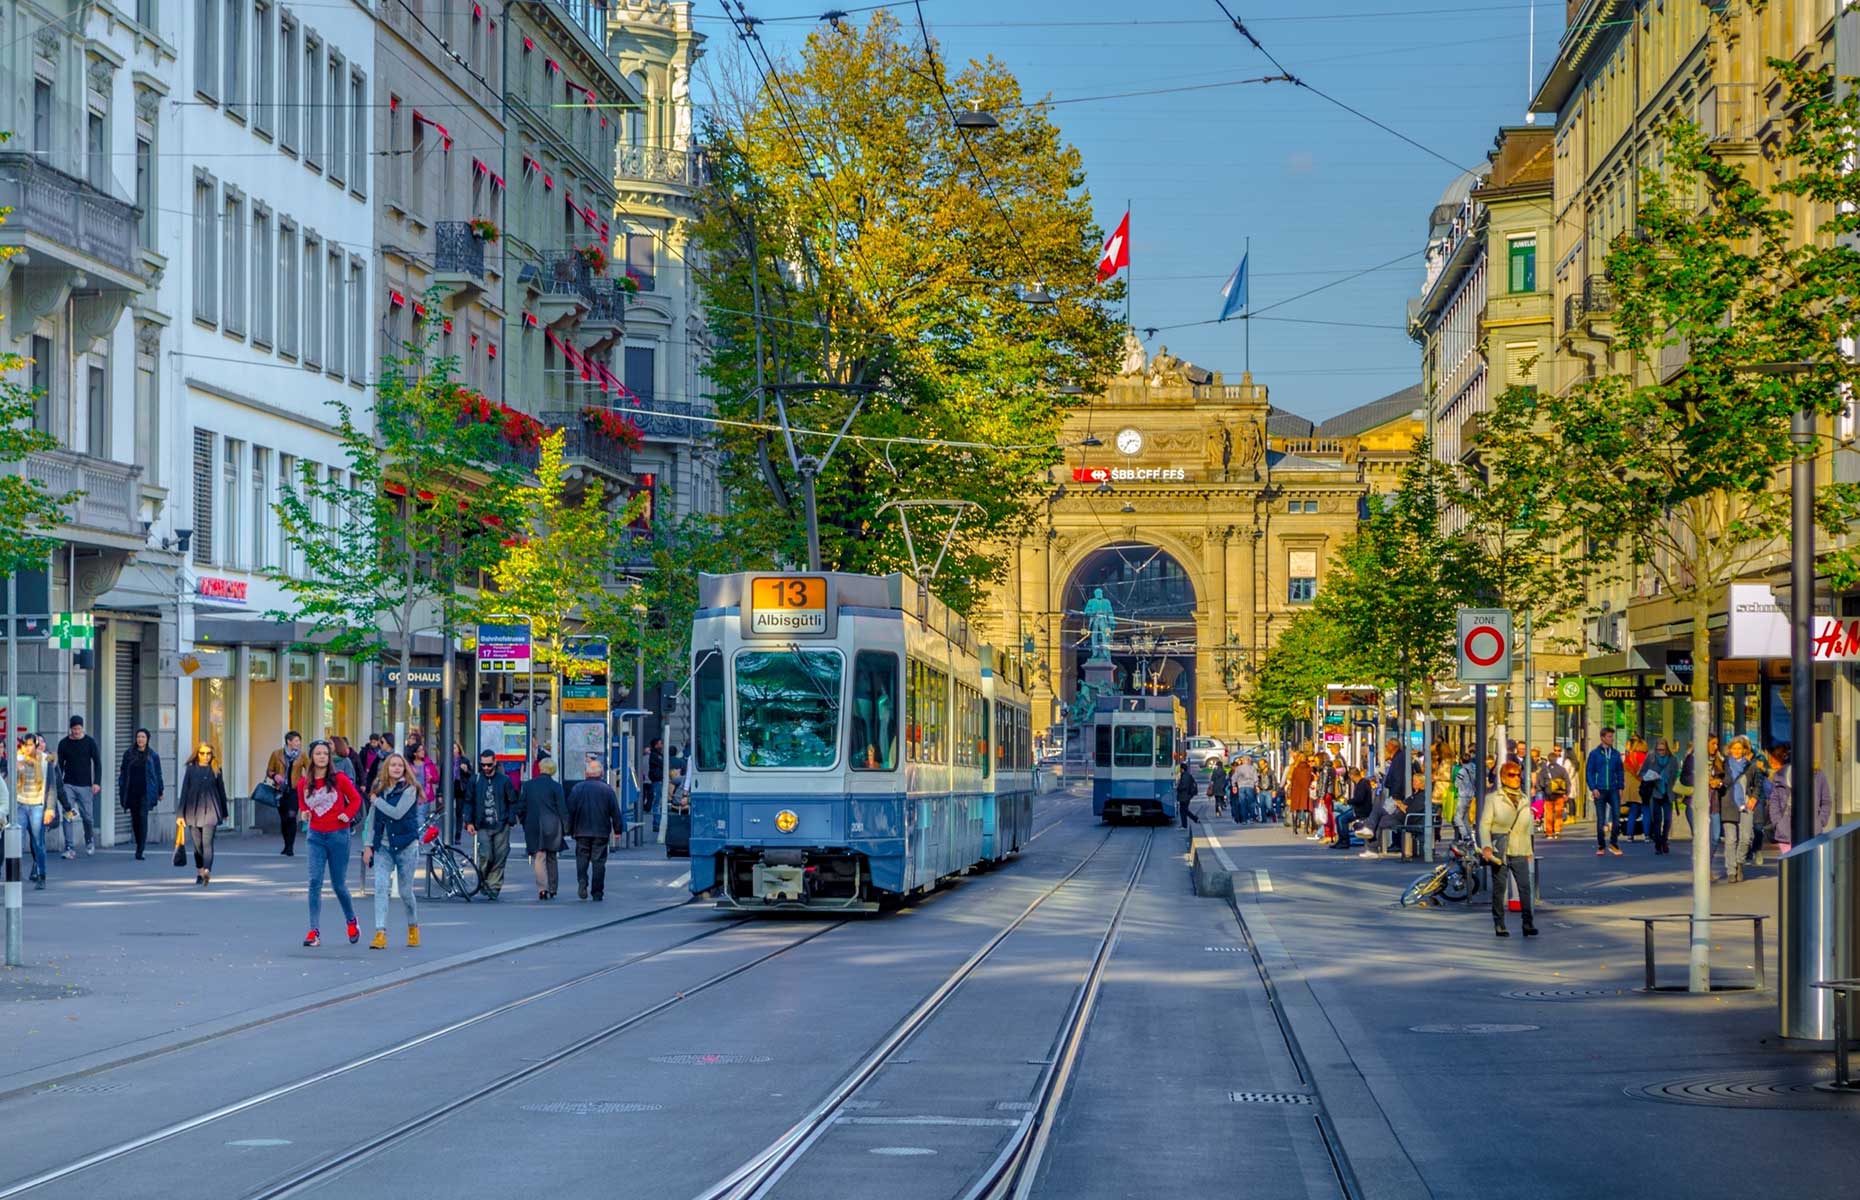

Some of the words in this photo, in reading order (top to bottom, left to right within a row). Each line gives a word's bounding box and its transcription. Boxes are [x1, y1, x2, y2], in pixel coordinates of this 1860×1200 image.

[1111, 470, 1133, 480] SBB
[1138, 470, 1161, 480] CFF
[1163, 470, 1185, 480] FFS
[772, 581, 808, 607] 13
[757, 614, 822, 628] Albisgütli
[1473, 616, 1496, 625] ZONE
[482, 649, 491, 657] 17
[1130, 700, 1138, 711] 7
